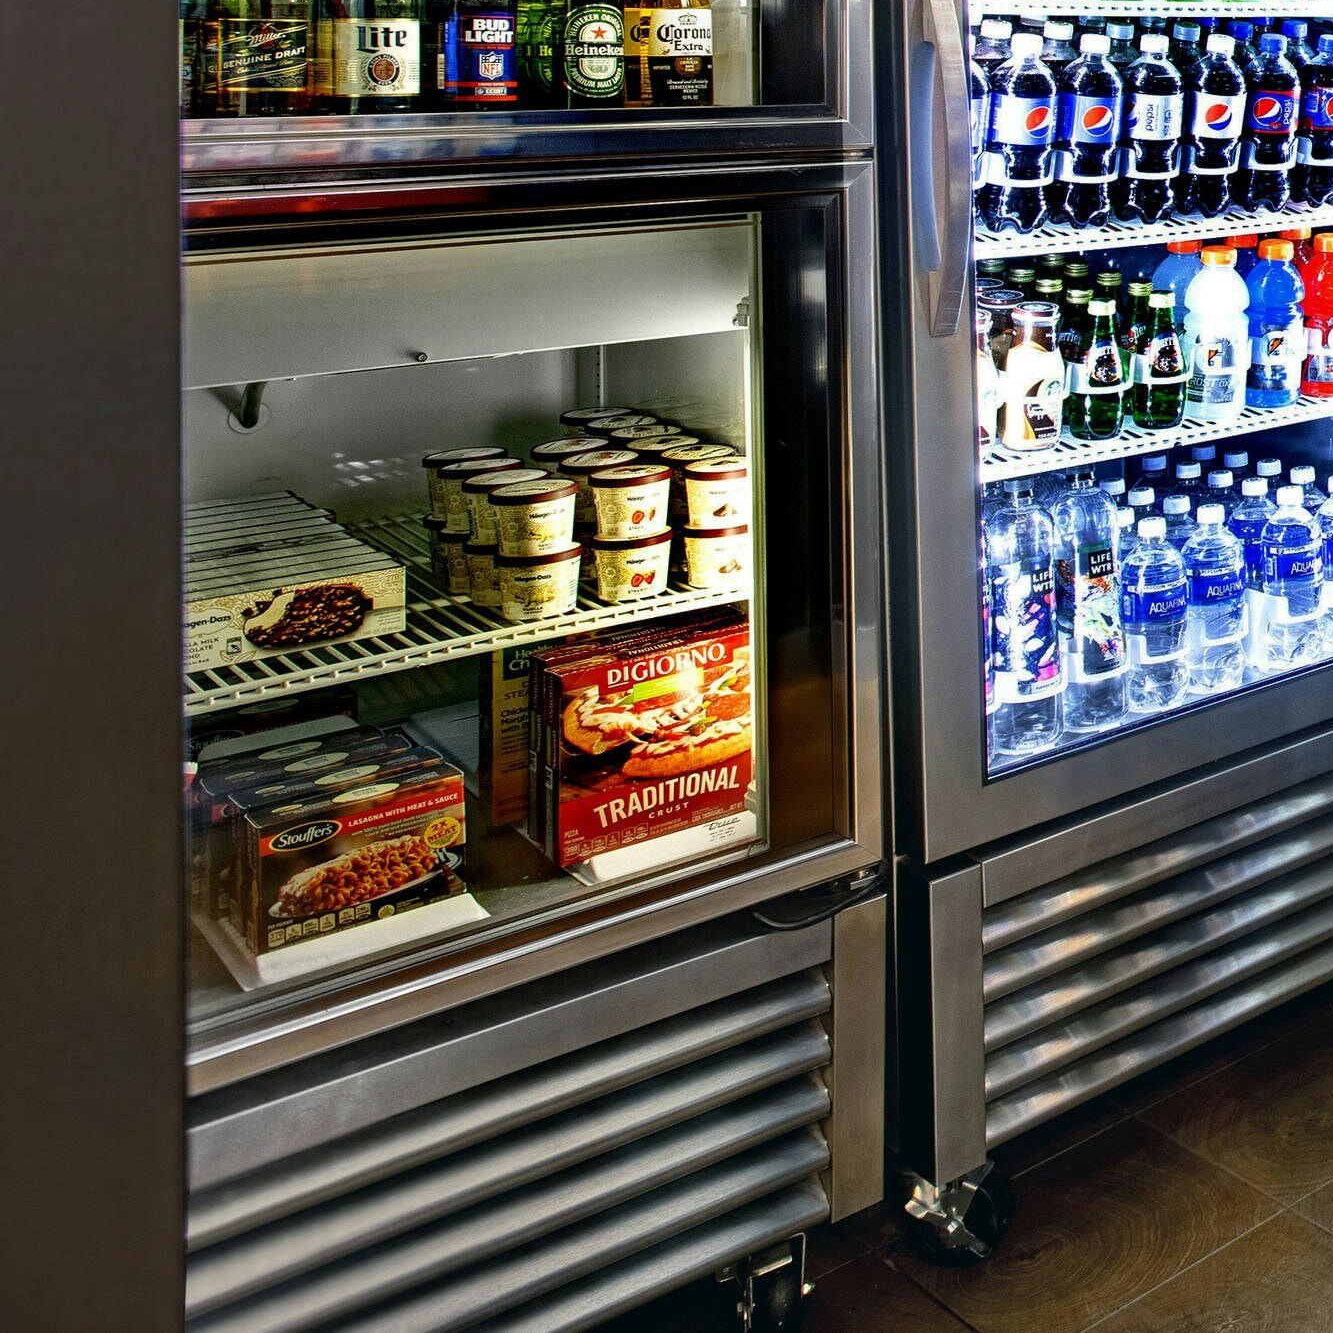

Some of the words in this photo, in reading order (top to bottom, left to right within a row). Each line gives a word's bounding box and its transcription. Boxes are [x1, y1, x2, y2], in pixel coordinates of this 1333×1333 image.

[473, 18, 509, 31] BUD
[357, 25, 407, 53] Lite
[465, 30, 514, 43] LIGHT
[657, 24, 711, 44] Corona
[275, 46, 306, 59] DRAFT
[674, 42, 704, 52] Extra
[1146, 103, 1154, 132] pepsi
[1283, 99, 1291, 125] pepsi
[1090, 553, 1111, 565] LIFE
[1091, 563, 1113, 575] WTR
[594, 765, 740, 828] TRADITIONAL
[348, 813, 384, 827] LASAGNA
[385, 807, 405, 818] WITH
[407, 802, 427, 813] MEAT
[434, 792, 459, 804] SAUCE
[648, 802, 690, 819] CRUST
[427, 825, 457, 843] MEAT
[431, 820, 447, 832] 2X
[278, 823, 333, 849] Stouffer's
